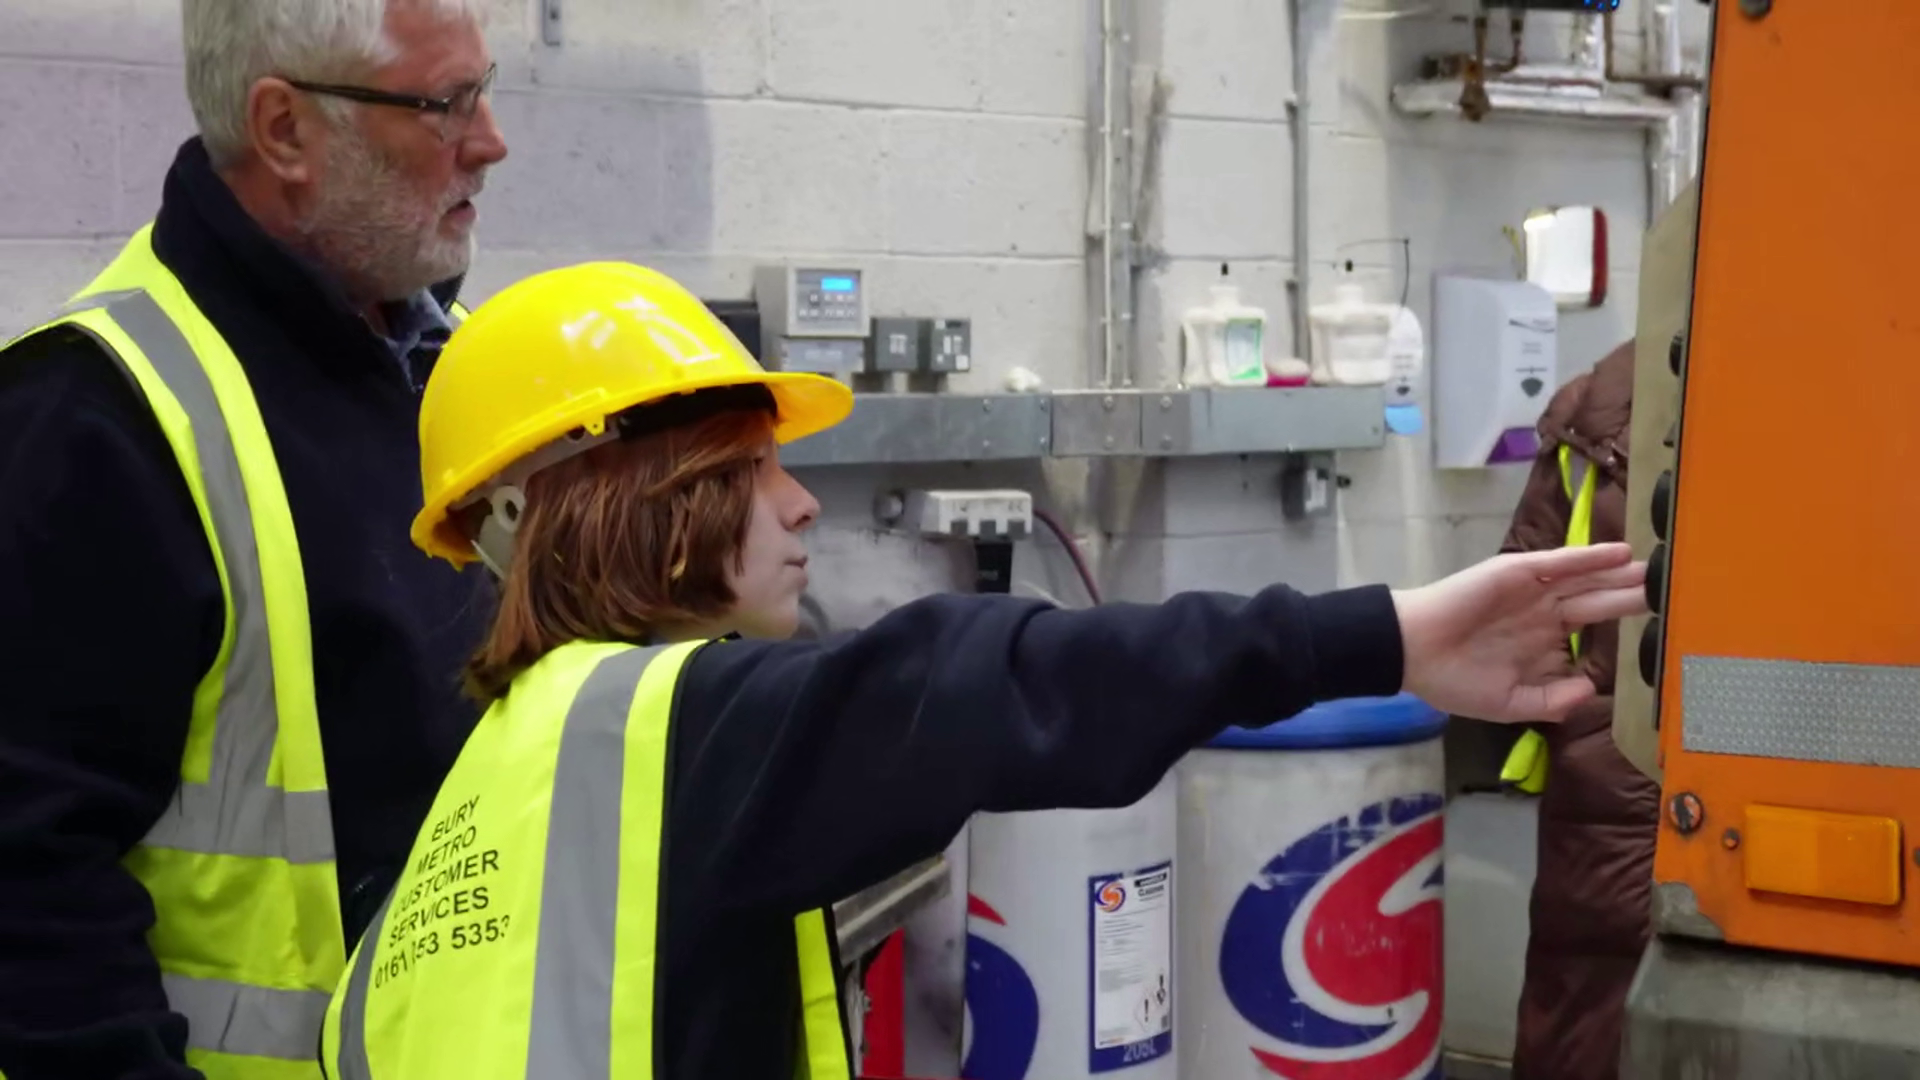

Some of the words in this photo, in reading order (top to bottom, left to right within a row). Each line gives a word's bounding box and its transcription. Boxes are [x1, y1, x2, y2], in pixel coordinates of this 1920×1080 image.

[431, 795, 480, 842] BURY
[417, 826, 476, 875] METRO
[394, 850, 499, 920] USTOMER
[389, 886, 490, 948] SERVICES
[375, 950, 408, 989] 0161
[412, 931, 440, 965] 53
